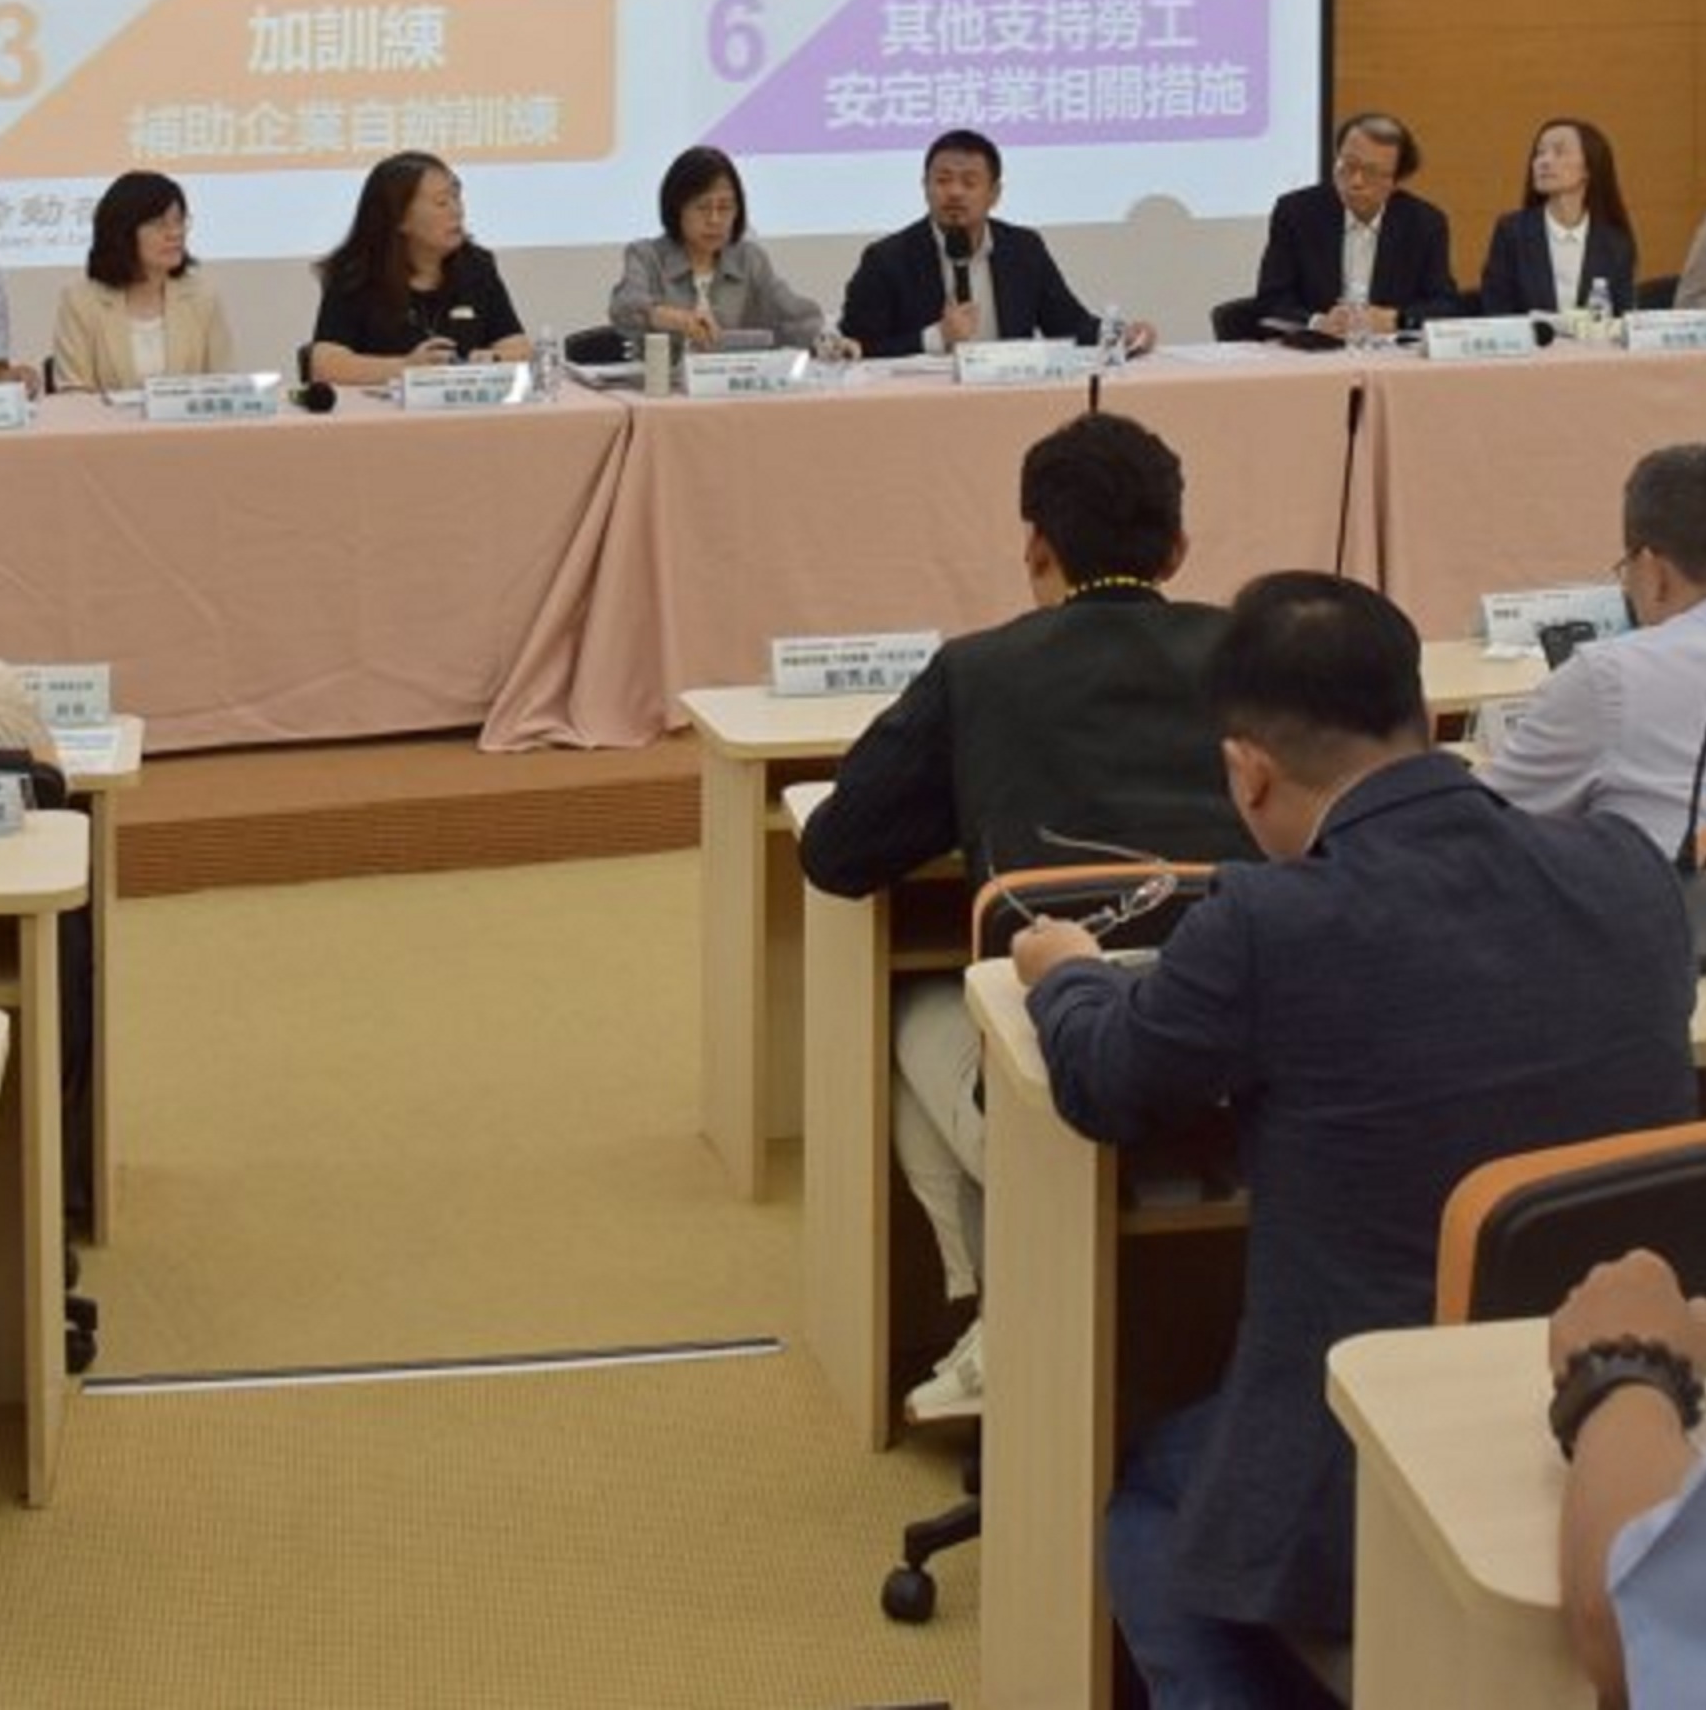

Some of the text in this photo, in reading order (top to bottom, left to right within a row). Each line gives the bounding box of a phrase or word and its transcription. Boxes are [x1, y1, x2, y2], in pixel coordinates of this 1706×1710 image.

[247, 5, 447, 74] 加訓練
[131, 94, 562, 158] 補助企業自辦訓練
[825, 61, 1247, 129] 安定就業相關措施
